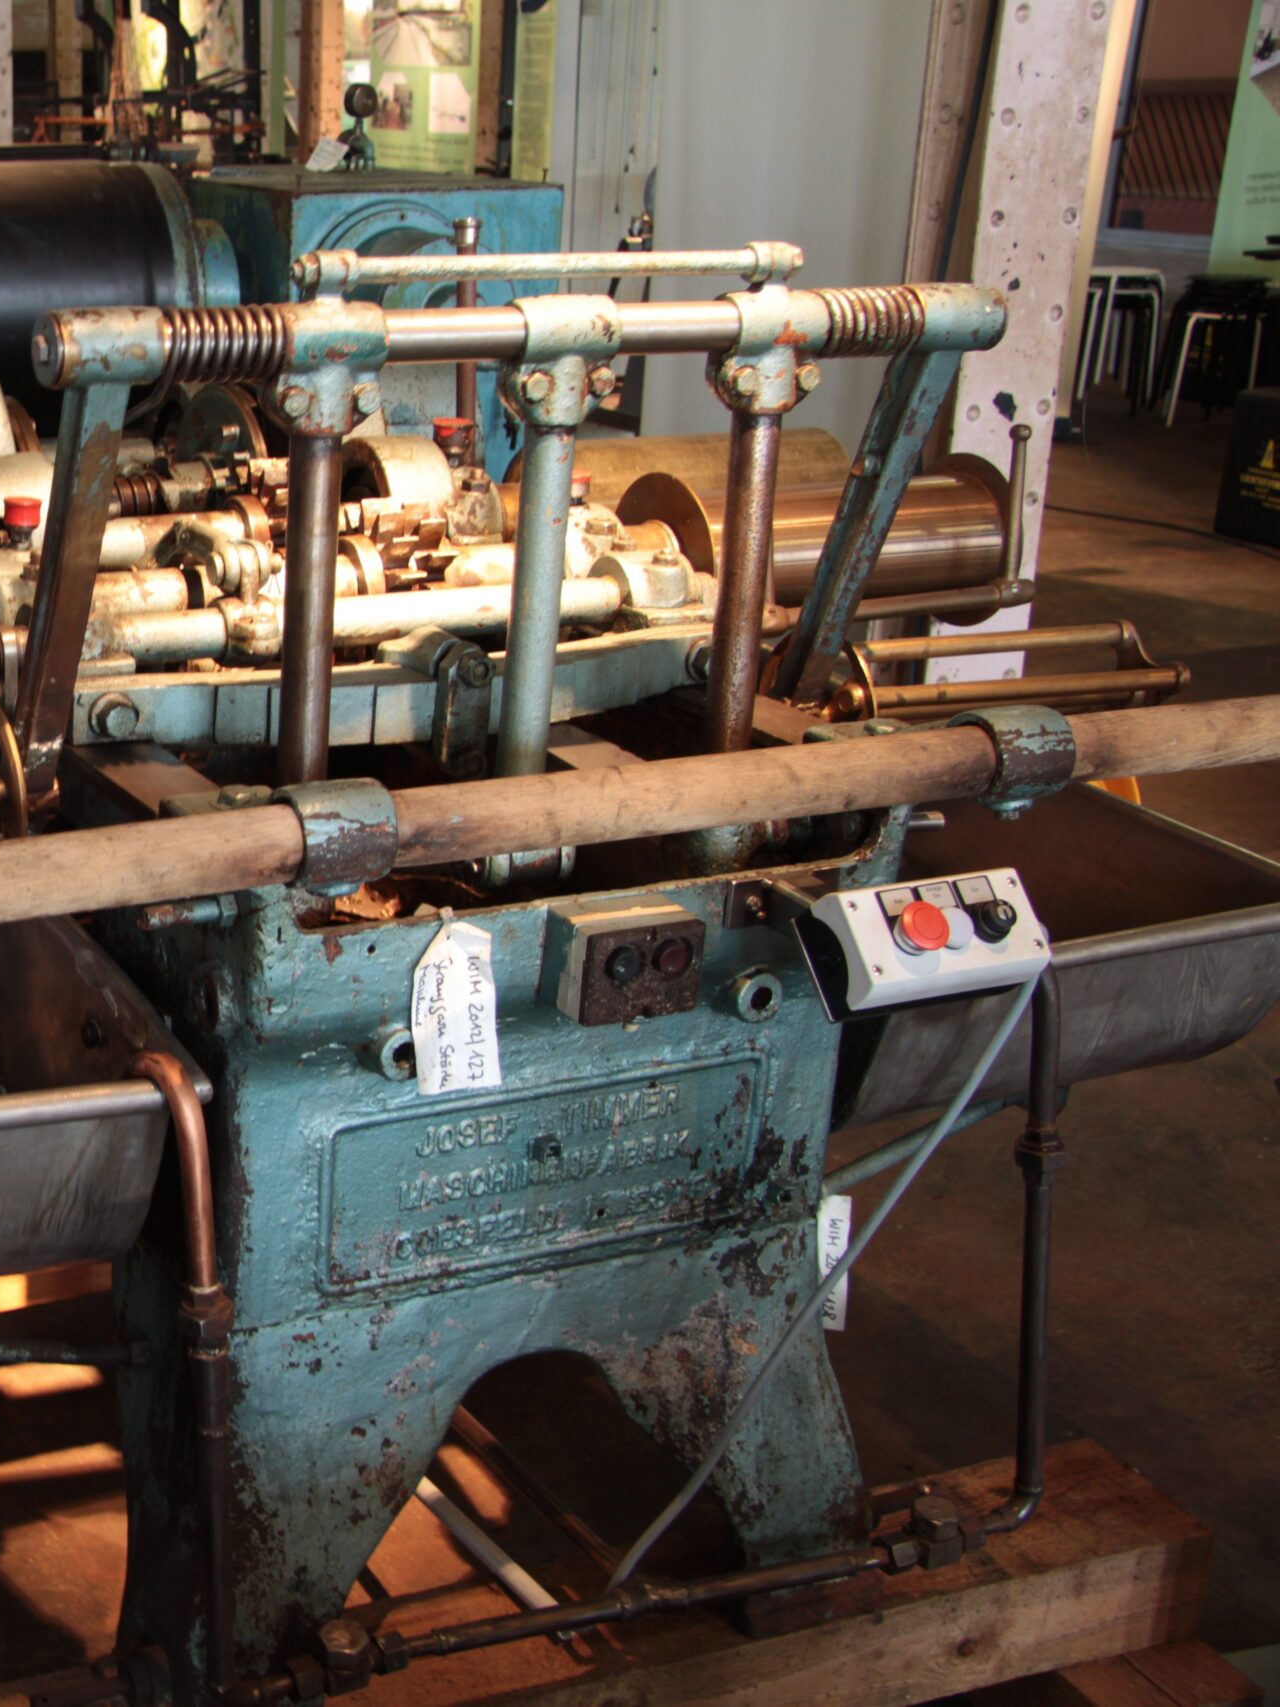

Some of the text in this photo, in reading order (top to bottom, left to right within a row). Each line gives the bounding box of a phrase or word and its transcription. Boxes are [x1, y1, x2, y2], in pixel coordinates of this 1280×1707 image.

[415, 1083, 681, 1159] JOSEF TIMMER
[397, 1129, 693, 1212] MASCHINENFABRIK
[394, 1202, 564, 1261] COESFELD
